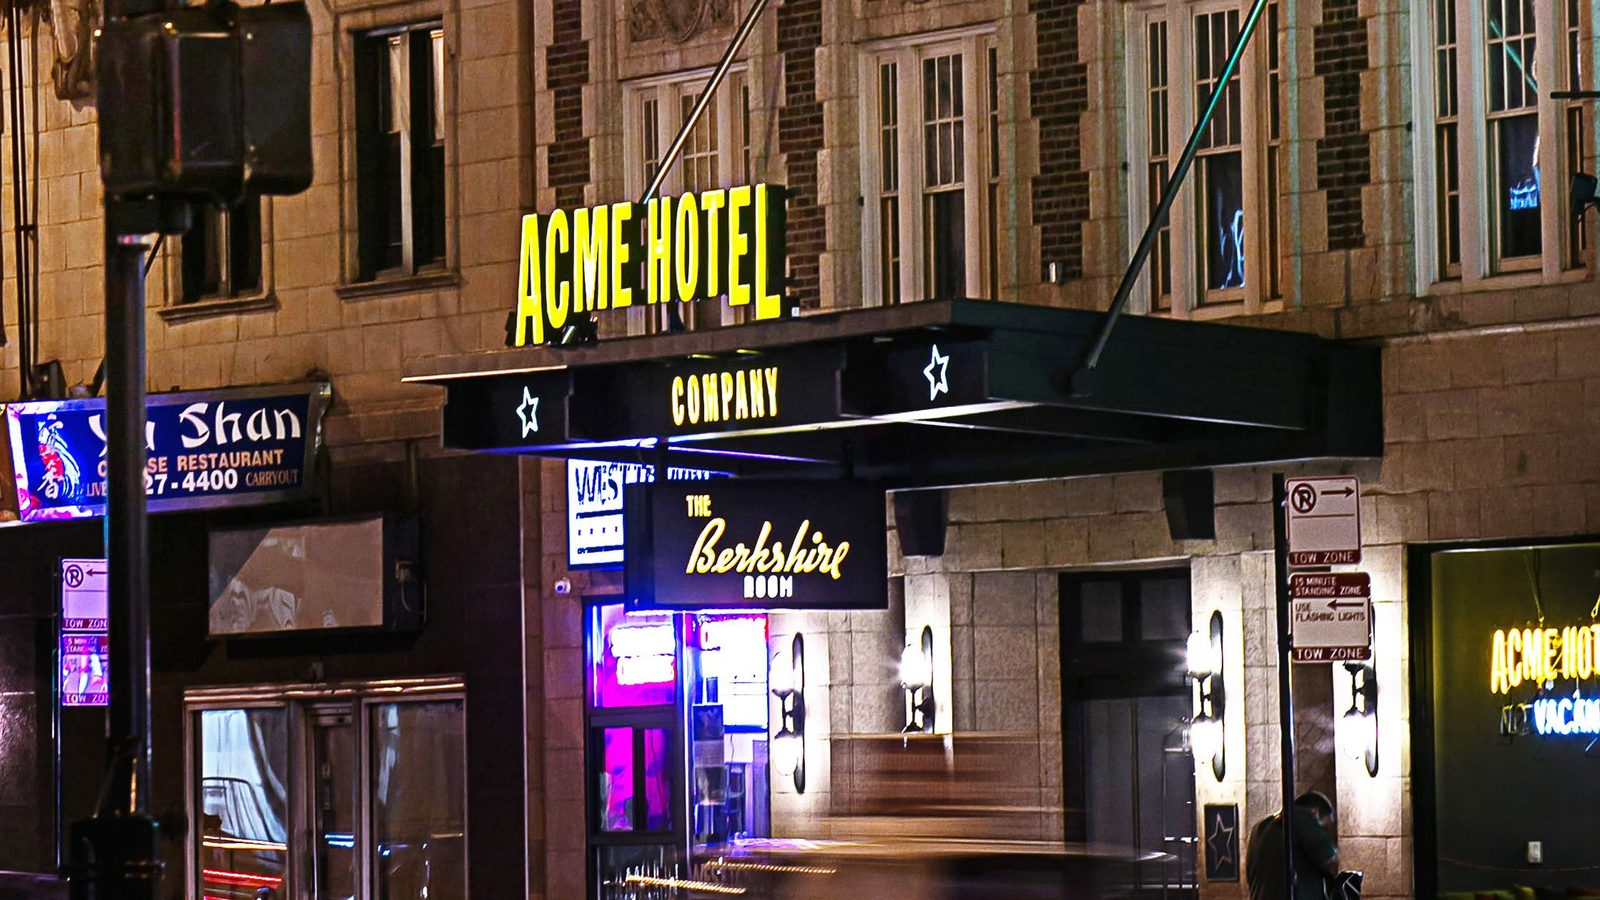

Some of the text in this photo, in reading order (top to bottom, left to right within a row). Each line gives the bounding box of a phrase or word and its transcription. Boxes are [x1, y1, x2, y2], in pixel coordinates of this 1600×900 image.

[516, 183, 780, 347] ACME HOTEL
[672, 367, 778, 426] COMPANY
[179, 401, 301, 448] Shan
[177, 449, 284, 472] RESTAURANT
[245, 469, 299, 486] CARRYOUT
[686, 494, 712, 517] THE
[686, 517, 850, 580] Berkshire
[1294, 551, 1354, 564] TOW ZONE
[743, 575, 793, 598] ROOM
[1306, 576, 1337, 586] MINUTE
[1295, 586, 1362, 596] STANDING ZONE
[1295, 602, 1311, 612] USE
[65, 619, 107, 628] TOW ZON
[1295, 611, 1366, 622] FLASHING LIGHTS
[1298, 648, 1364, 660] TOW ZONE
[1490, 627, 1559, 694] ACME
[66, 693, 87, 703] TOW
